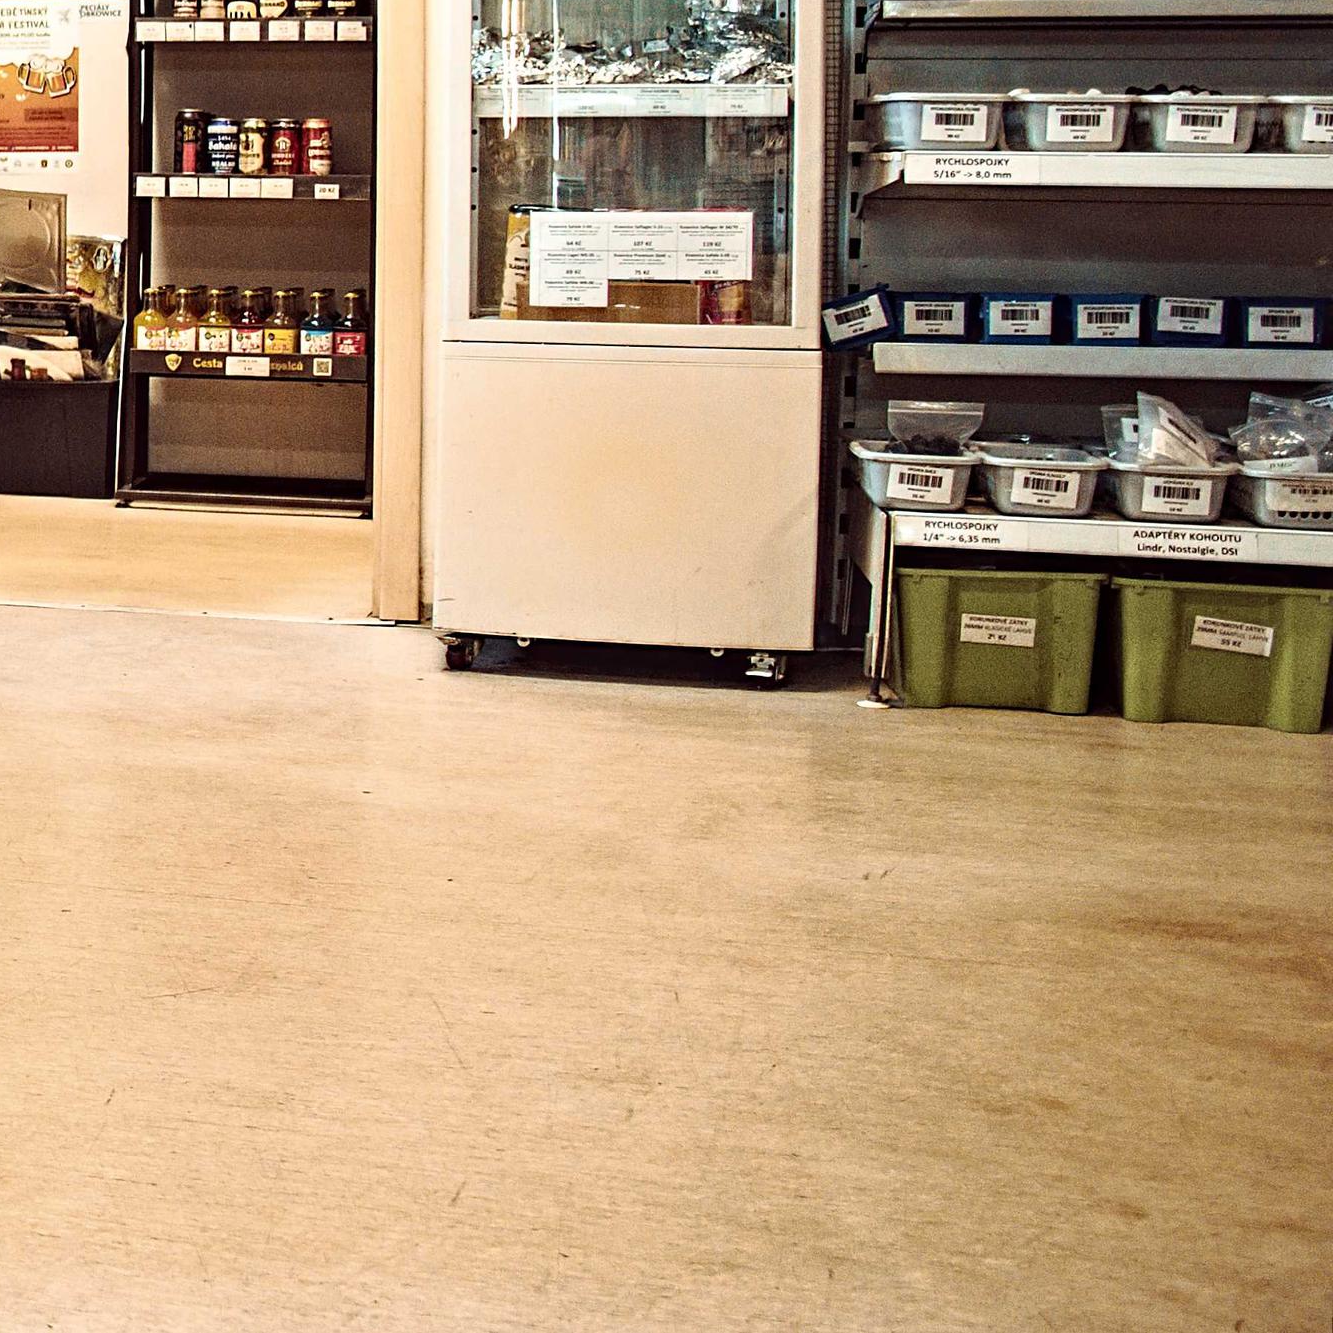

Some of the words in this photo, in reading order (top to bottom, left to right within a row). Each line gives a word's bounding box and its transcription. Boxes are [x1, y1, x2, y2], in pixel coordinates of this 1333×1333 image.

[935, 157, 1010, 167] RYCHLOSPOJKY
[975, 170, 991, 179] 8,0
[993, 171, 1012, 179] mm
[192, 358, 223, 369] Cesta
[924, 520, 999, 532] RYCHLOSPOJKY
[958, 535, 979, 545] 6,35
[981, 537, 1001, 545] mm
[1132, 530, 1186, 541] ADAPTÉRY
[1189, 532, 1243, 543] KOHOUTU
[1137, 543, 1166, 555] Lindr,
[1168, 544, 1219, 557] Nostalgie,
[1221, 546, 1239, 556] DSI
